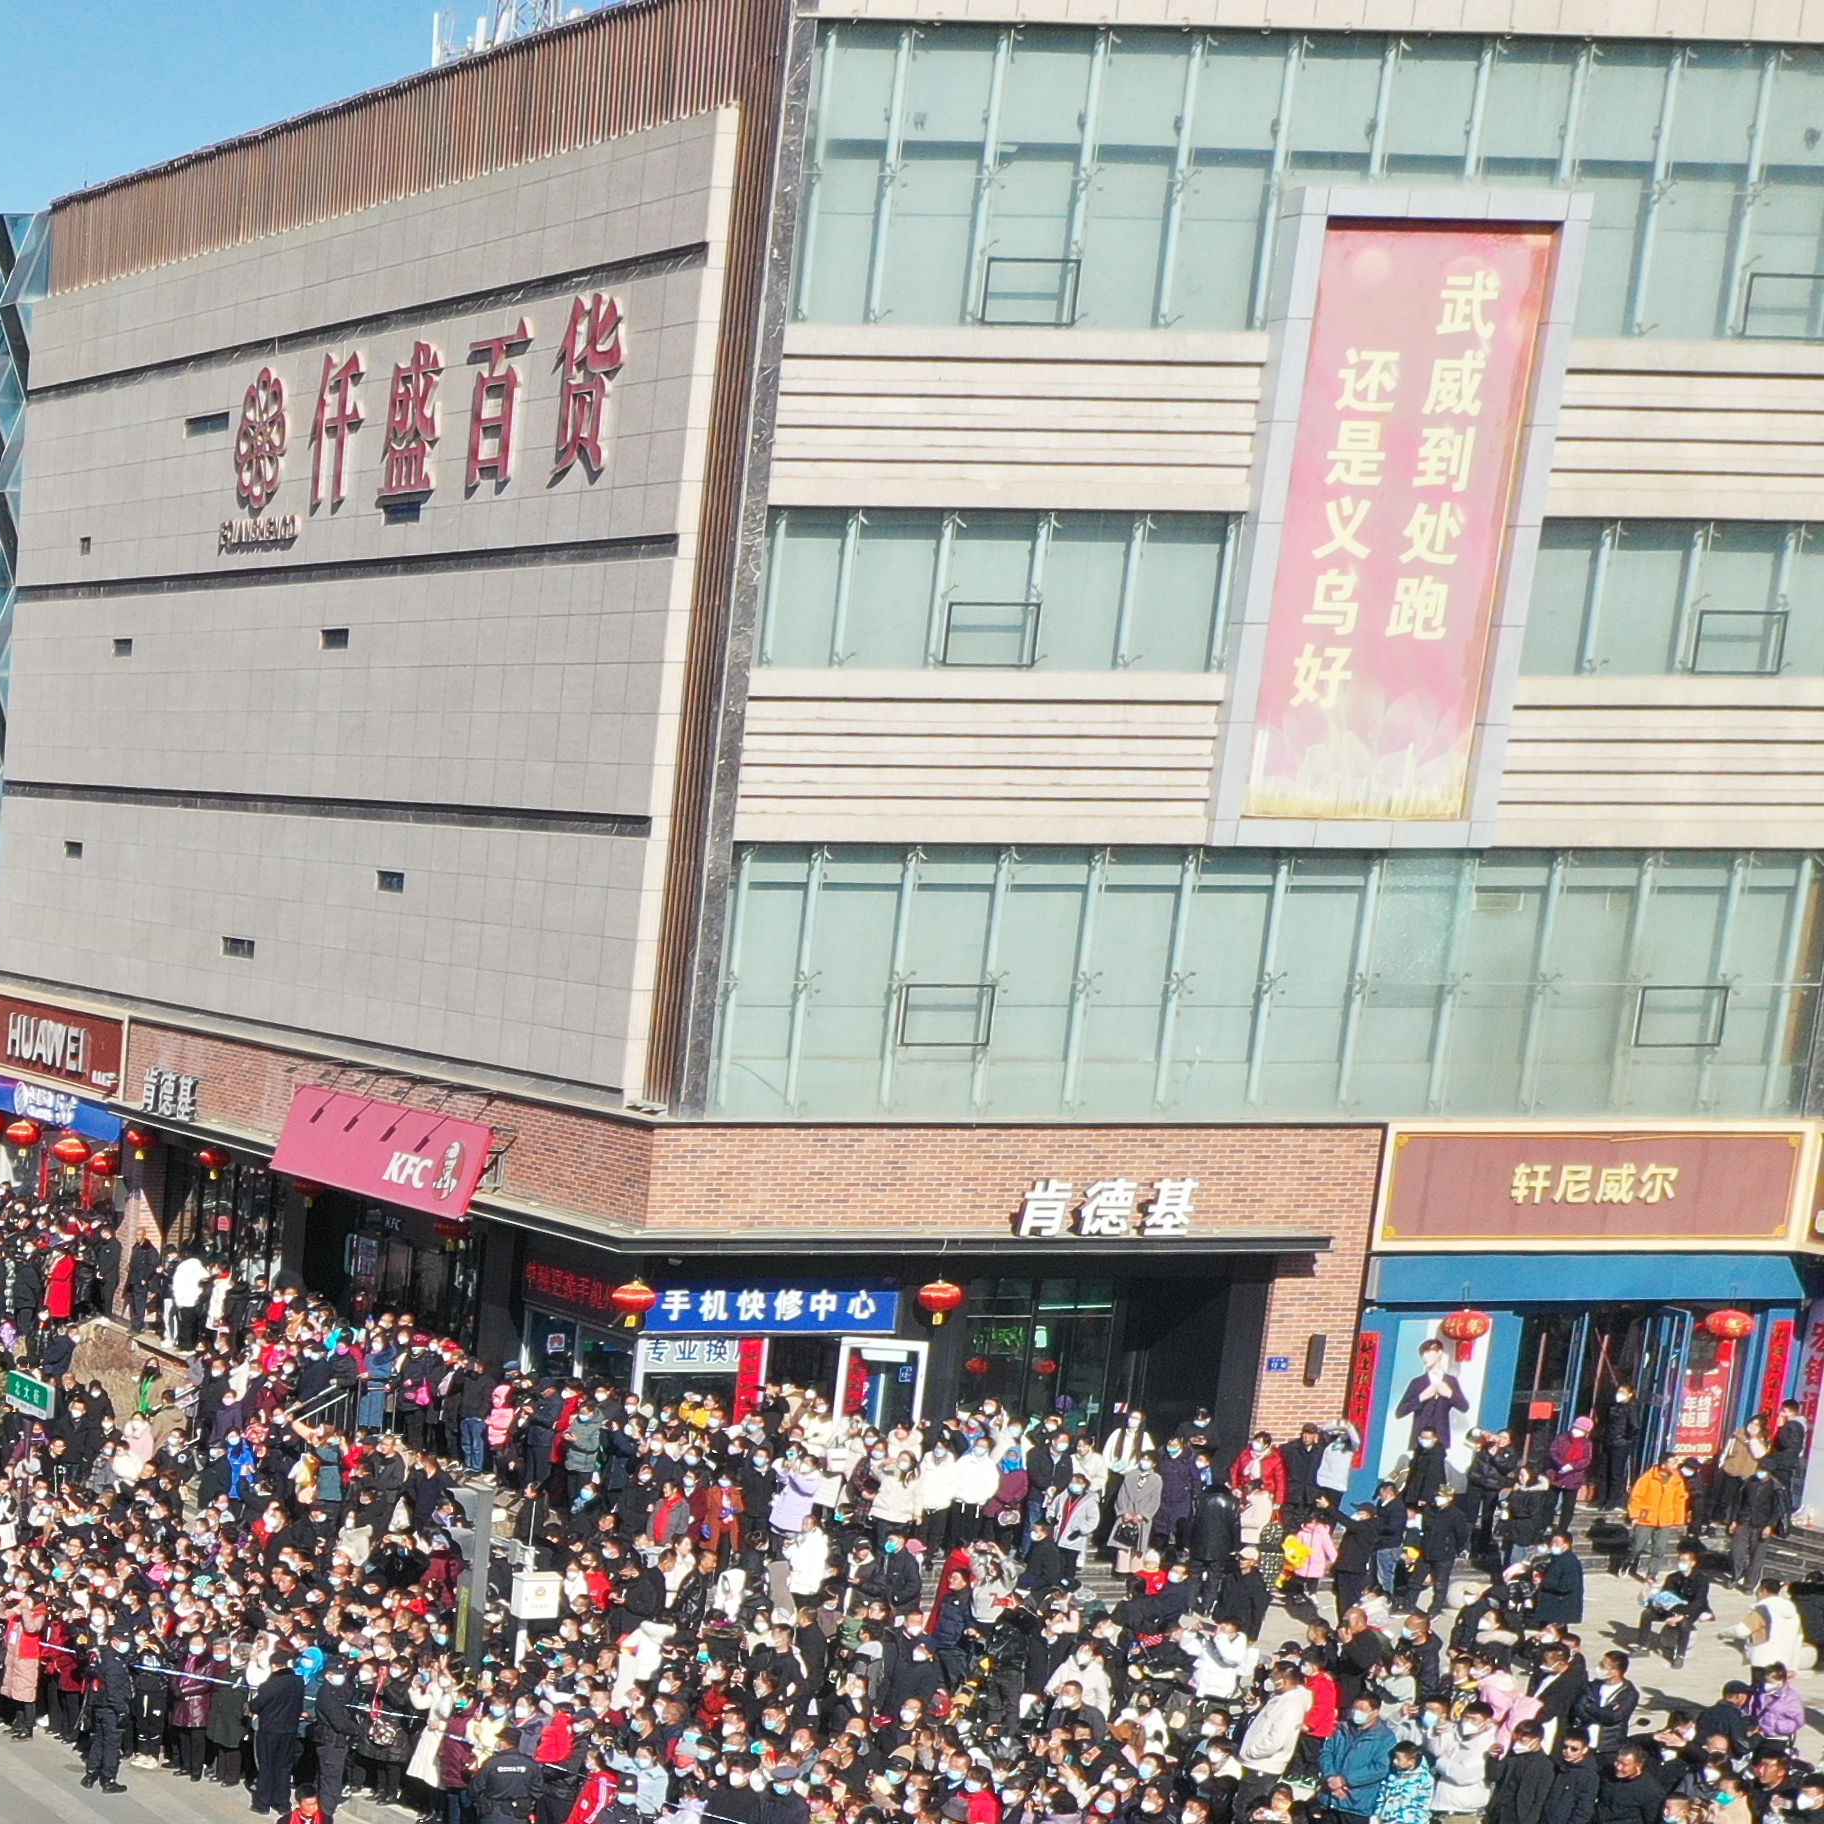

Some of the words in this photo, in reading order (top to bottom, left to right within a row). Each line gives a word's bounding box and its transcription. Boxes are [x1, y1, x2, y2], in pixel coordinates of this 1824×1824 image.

[311, 292, 627, 505] 仟盛百货
[1386, 271, 1499, 641] 武威到处跑
[1290, 347, 1401, 709] 还是义乌好
[7, 1012, 90, 1073] HUAWEI
[142, 1066, 200, 1122] 肯德基
[382, 1152, 433, 1188] KFC
[1509, 1163, 1679, 1205] 轩尼威尔
[384, 1215, 402, 1231] KFC
[1015, 1179, 1201, 1238] 肯德基
[661, 1289, 877, 1321] 手机快修中心
[646, 1339, 739, 1362] 专业换
